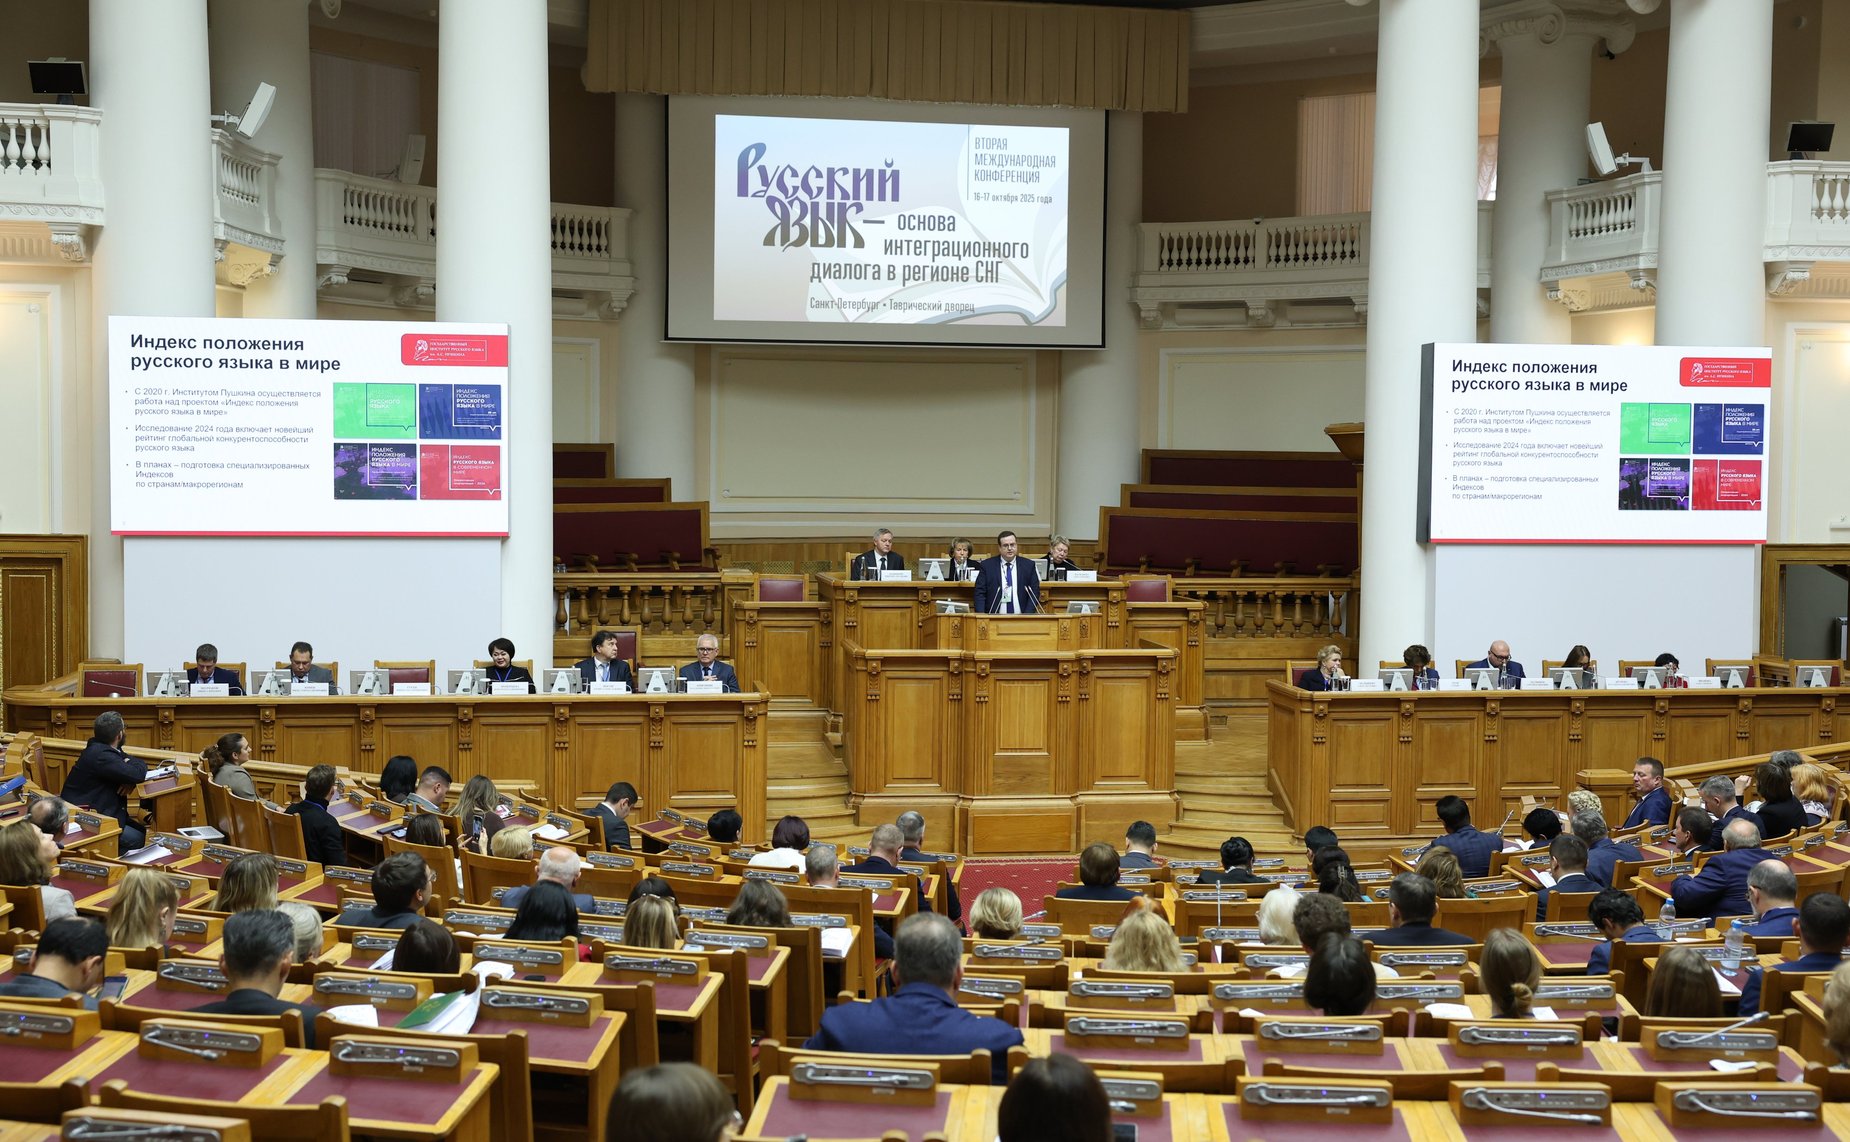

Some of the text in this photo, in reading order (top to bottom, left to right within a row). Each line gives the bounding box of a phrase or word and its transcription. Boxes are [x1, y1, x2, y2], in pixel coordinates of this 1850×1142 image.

[975, 137, 1008, 150] ВТОРАЯ
[975, 153, 1056, 169] МЕЖДУНАРОДНАЯ
[974, 169, 1040, 184] КОНФЕРЕНЦИЯ
[974, 192, 1052, 204] 16-17 октября 2025 года
[897, 214, 956, 230] основа
[884, 238, 1030, 262] интеграционного
[810, 261, 1003, 287] диалога в регионе СНГ
[810, 297, 975, 314] Санкт-Петербург Таврический дворец
[131, 334, 304, 351] Индекс положения
[131, 356, 341, 374] русского языка в мире
[1452, 359, 1597, 374] Индекс положения
[1452, 380, 1628, 394] русского языка в мире
[143, 388, 162, 396] 2020
[172, 388, 219, 399] Институтом
[220, 389, 255, 397] Пушкина
[134, 397, 162, 406] работа
[165, 399, 179, 407] над
[182, 399, 219, 407] проектом
[221, 399, 253, 407] «Индекс
[135, 408, 169, 416] русского
[203, 409, 228, 417] мире»
[1485, 409, 1524, 418] Институтом
[1525, 409, 1555, 417] Пушкина
[1493, 418, 1524, 426] проектом
[1526, 418, 1553, 426] «Индекс
[135, 425, 193, 434] Исследование
[216, 426, 233, 434] года
[274, 426, 313, 434] новейший
[135, 434, 308, 444] рейтинг глобальной конкурентоспособности
[136, 445, 169, 453] русского
[1453, 442, 1501, 450] Исследование
[181, 462, 224, 470] подготовка
[226, 463, 310, 471] специализированных
[136, 471, 174, 480] Индексов
[147, 480, 243, 489] странам/макрорегионам
[1452, 484, 1484, 492] Индексов
